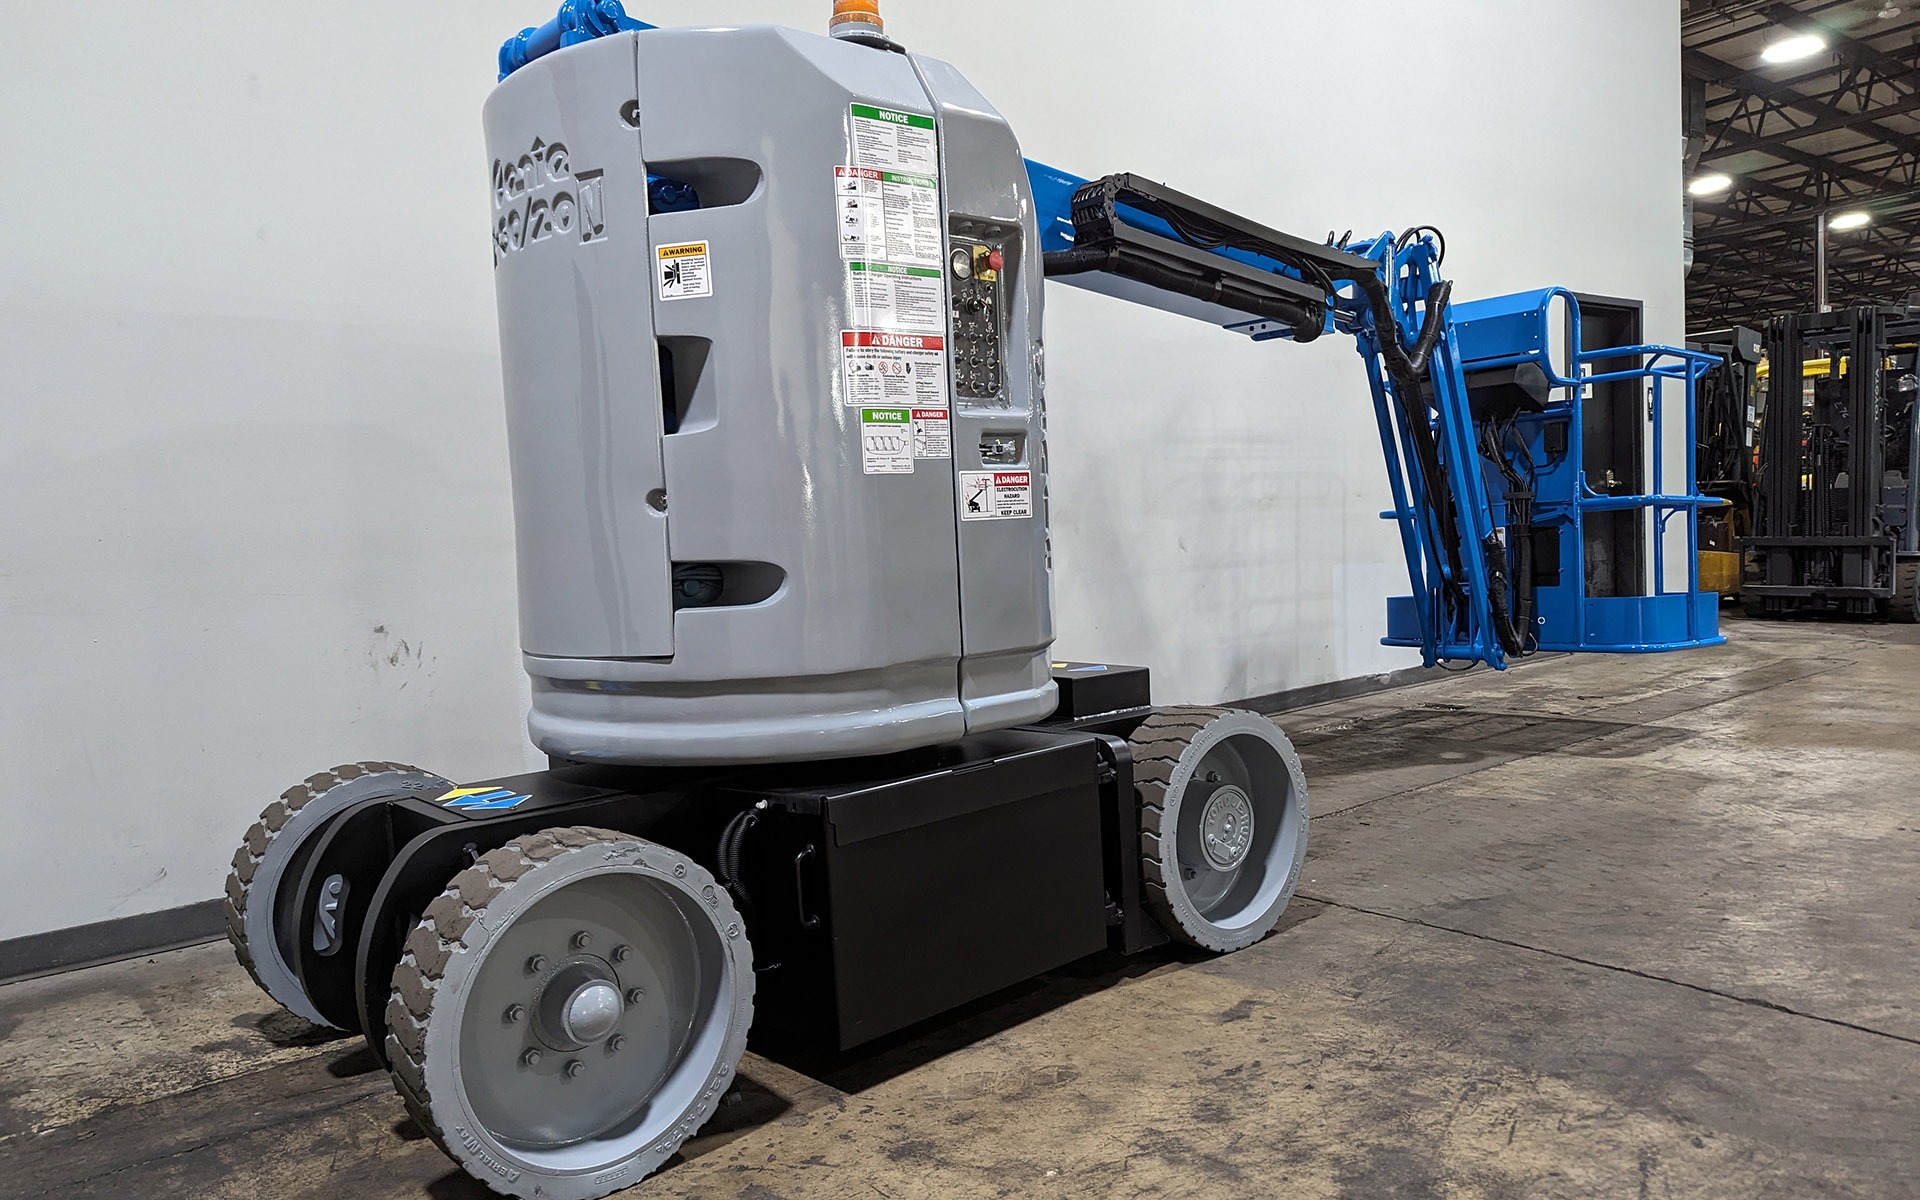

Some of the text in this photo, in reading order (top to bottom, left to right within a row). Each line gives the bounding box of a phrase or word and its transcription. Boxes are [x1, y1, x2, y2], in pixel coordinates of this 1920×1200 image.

[879, 110, 909, 124] NOTICE
[669, 246, 703, 256] WARNING
[881, 335, 923, 348] DANGER
[872, 412, 902, 420] NOTICE
[1001, 475, 1028, 484] DANGER
